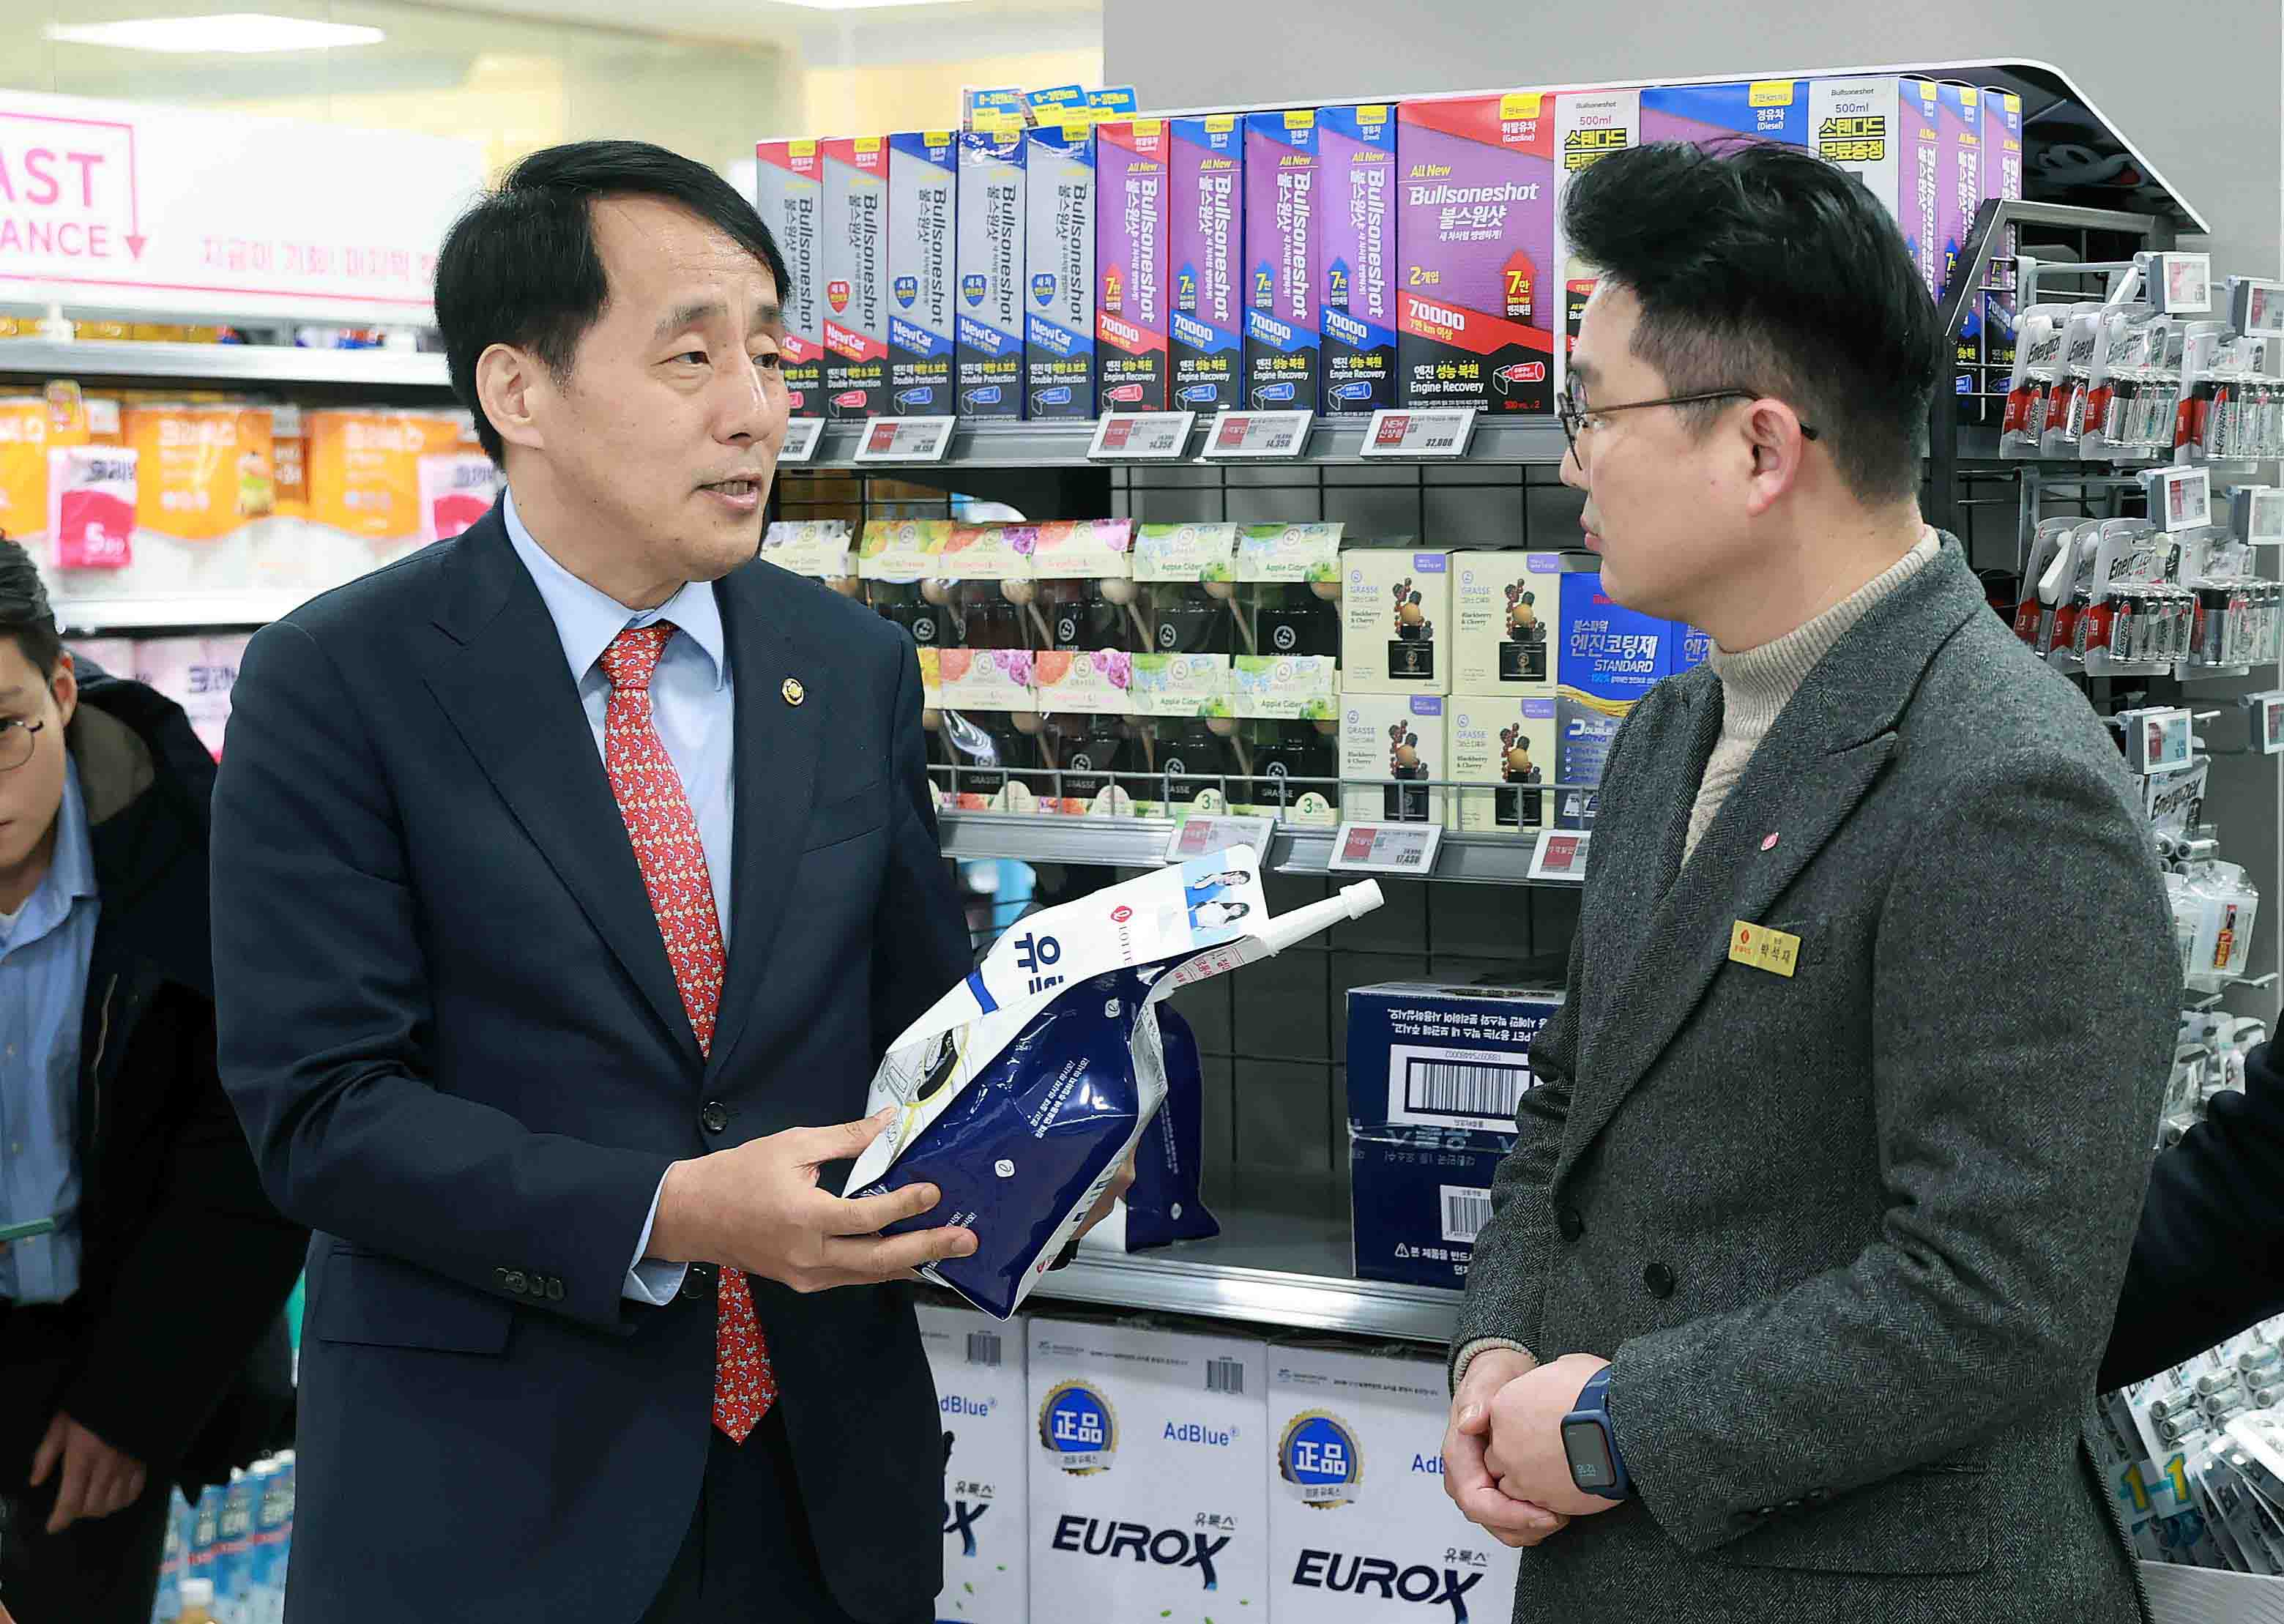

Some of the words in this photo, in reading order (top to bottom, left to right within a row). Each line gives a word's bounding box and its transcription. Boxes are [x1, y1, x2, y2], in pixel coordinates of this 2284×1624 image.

[1835, 103, 1869, 113] 500ml
[1580, 115, 1611, 126] 500ml
[1757, 108, 1785, 122] 경유차
[1501, 121, 1536, 133] 휘발유차
[1757, 122, 1784, 132] (Diesel)
[1502, 133, 1535, 143] (Gasoline)
[1818, 139, 1886, 162] 무료증정
[1279, 157, 1293, 165] All
[1294, 156, 1312, 165] New
[1353, 152, 1364, 162] All
[1365, 152, 1384, 161] New
[1128, 163, 1139, 171] All
[1139, 163, 1158, 171] New
[1200, 160, 1213, 169] All
[1213, 159, 1232, 169] New
[1410, 165, 1426, 176] All
[1427, 165, 1451, 176] New
[1350, 169, 1366, 229] 불스원샷
[1407, 182, 1540, 205] Bullsoneshot
[1125, 179, 1140, 236] 불스원샷
[1199, 176, 1213, 235] 불스원샷
[1277, 172, 1292, 231] 불스원샷
[1439, 205, 1507, 230] 불스원샷
[1214, 175, 1232, 321] Bullsoneshot
[1292, 171, 1311, 319] Bullsoneshot
[1368, 168, 1385, 317] Bullsoneshot
[1000, 184, 1016, 324] Bullsoneshot
[1070, 183, 1087, 325] Bullsoneshot
[1141, 177, 1158, 322] Bullsoneshot
[863, 193, 878, 331] Bullsoneshot
[931, 187, 948, 326] Bullsoneshot
[799, 197, 815, 334] Bullsoneshot
[1410, 266, 1439, 285] 2개입
[1506, 270, 1530, 294] 7만
[1408, 299, 1465, 331] 70000
[1101, 315, 1139, 342] 70000
[1174, 313, 1213, 342] 70000
[1250, 311, 1291, 340] 70000
[1325, 310, 1367, 339] 70000
[1410, 318, 1423, 330] 7만
[1423, 321, 1435, 334] km
[1437, 327, 1453, 340] 이상
[1106, 360, 1120, 371] 엔진
[1180, 360, 1194, 371] 엔진
[1256, 358, 1271, 370] 엔진
[1332, 357, 1348, 368] 엔진
[1253, 370, 1276, 381] Engine
[1277, 370, 1309, 380] Recovery
[1329, 370, 1353, 379] Engine
[1354, 369, 1386, 379] Recovery
[1413, 364, 1434, 379] 엔진
[1436, 363, 1457, 379] 성능
[1458, 362, 1479, 379] 복원
[893, 376, 915, 385] Double
[915, 375, 947, 384] Protection
[961, 375, 982, 384] Double
[983, 374, 1016, 384] Protection
[1030, 375, 1052, 384] Double
[1053, 375, 1086, 384] Protection
[1104, 373, 1125, 382] Engine
[1126, 372, 1156, 381] Recovery
[1177, 372, 1199, 382] Engine
[1199, 372, 1230, 381] Recovery
[827, 379, 848, 389] Double
[849, 379, 881, 388] Protection
[1410, 381, 1441, 394] Engine
[1443, 381, 1484, 393] Recovery
[1383, 420, 1405, 429] NEW
[1161, 562, 1181, 573] Apple
[1183, 561, 1202, 571] Cider
[1265, 562, 1286, 573] Apple
[1287, 562, 1307, 572] Cider
[1351, 610, 1380, 619] Blackberry
[1461, 611, 1492, 620] Blackberry
[1356, 617, 1375, 626] Cherry
[1468, 618, 1486, 627] Cherry
[1569, 634, 1658, 660] 엔진코팅제
[1593, 660, 1654, 672] STANDARD
[1160, 697, 1180, 707] Apple
[1182, 696, 1200, 706] Cider
[1260, 699, 1282, 709] Apple
[1283, 700, 1303, 709] Cider
[1347, 751, 1377, 760] Blackberry
[1457, 755, 1487, 764] Blackberry
[1353, 758, 1371, 766] Cherry
[1464, 762, 1483, 771] Cherry
[1387, 1008, 1441, 1022] 사용하십시오.
[1443, 1012, 1478, 1024] 분리하여
[1481, 1014, 1507, 1027] 박스와
[1509, 1016, 1536, 1028] 시에만
[1392, 1022, 1421, 1035] 주시고,
[1423, 1024, 1449, 1037] 보관해
[1451, 1027, 1460, 1038] 내
[1462, 1027, 1481, 1039] 박스
[1483, 1027, 1510, 1040] 용기는
[1511, 1031, 1531, 1041] PET
[1410, 1246, 1419, 1257] 본
[1422, 1248, 1448, 1261] 제품을
[1054, 1410, 1103, 1443] 正品
[1295, 1440, 1347, 1476] 正品
[955, 1480, 993, 1499] 유록스
[1194, 1512, 1235, 1530] 유록스
[1052, 1514, 1232, 1591] EUROX
[1444, 1547, 1488, 1567] 유록스
[1292, 1549, 1484, 1624] EUROX
